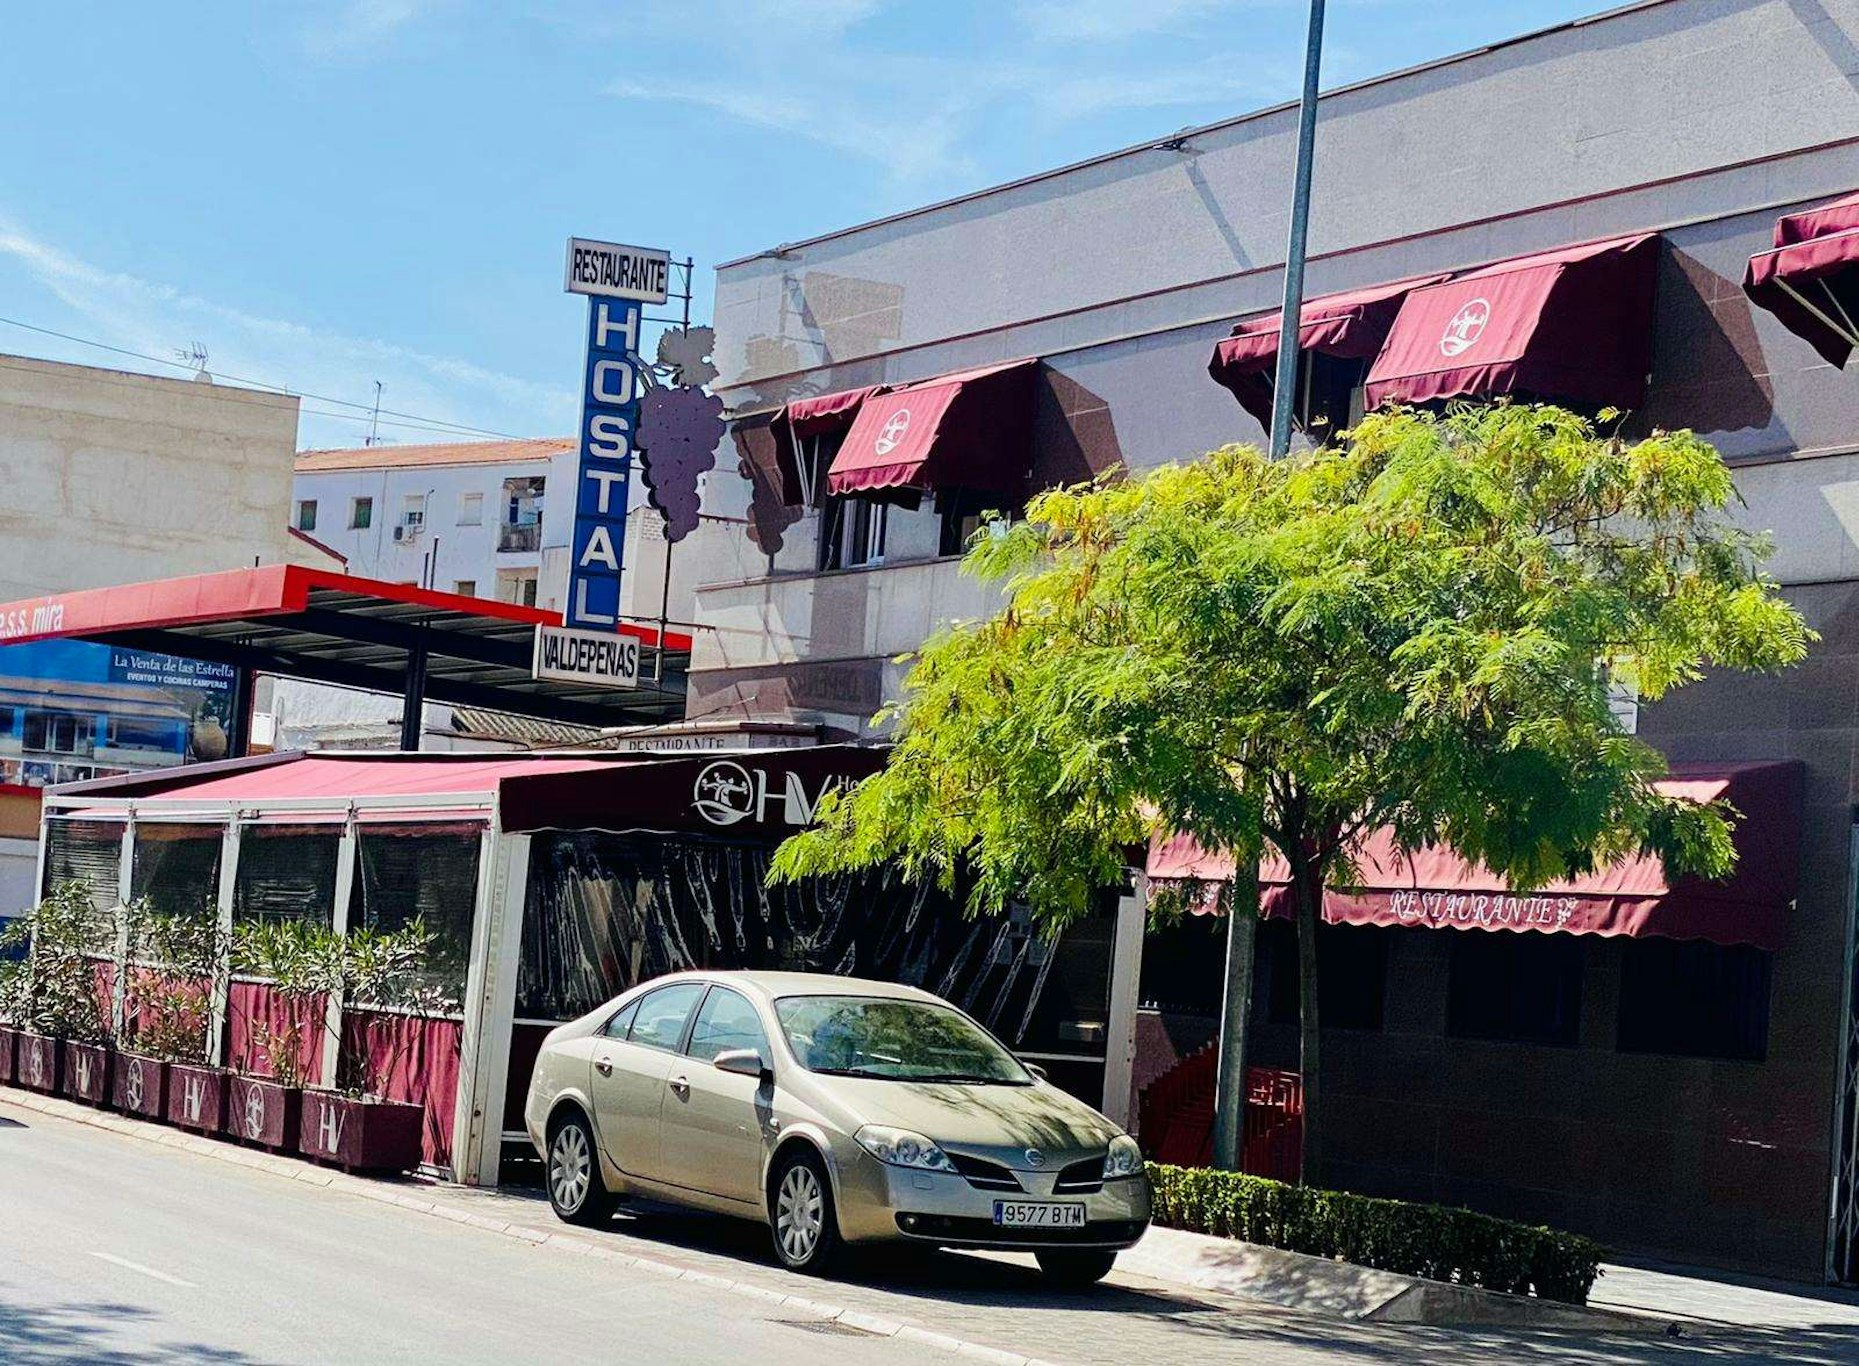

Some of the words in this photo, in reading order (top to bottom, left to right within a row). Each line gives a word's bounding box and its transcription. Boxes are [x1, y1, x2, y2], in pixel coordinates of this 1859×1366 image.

[573, 248, 665, 294] RESTAURANTE
[575, 303, 637, 625] HOSTAL
[32, 597, 64, 635] mira
[114, 654, 128, 668] La
[130, 655, 161, 671] Venta
[162, 658, 179, 673] de
[178, 659, 195, 674] las
[543, 634, 636, 678] VALDEPEÑAS
[752, 768, 833, 826] HV
[1389, 889, 1553, 925] RESTAURANTE
[1004, 1205, 1048, 1223] 9577
[1052, 1206, 1082, 1224] BTM
